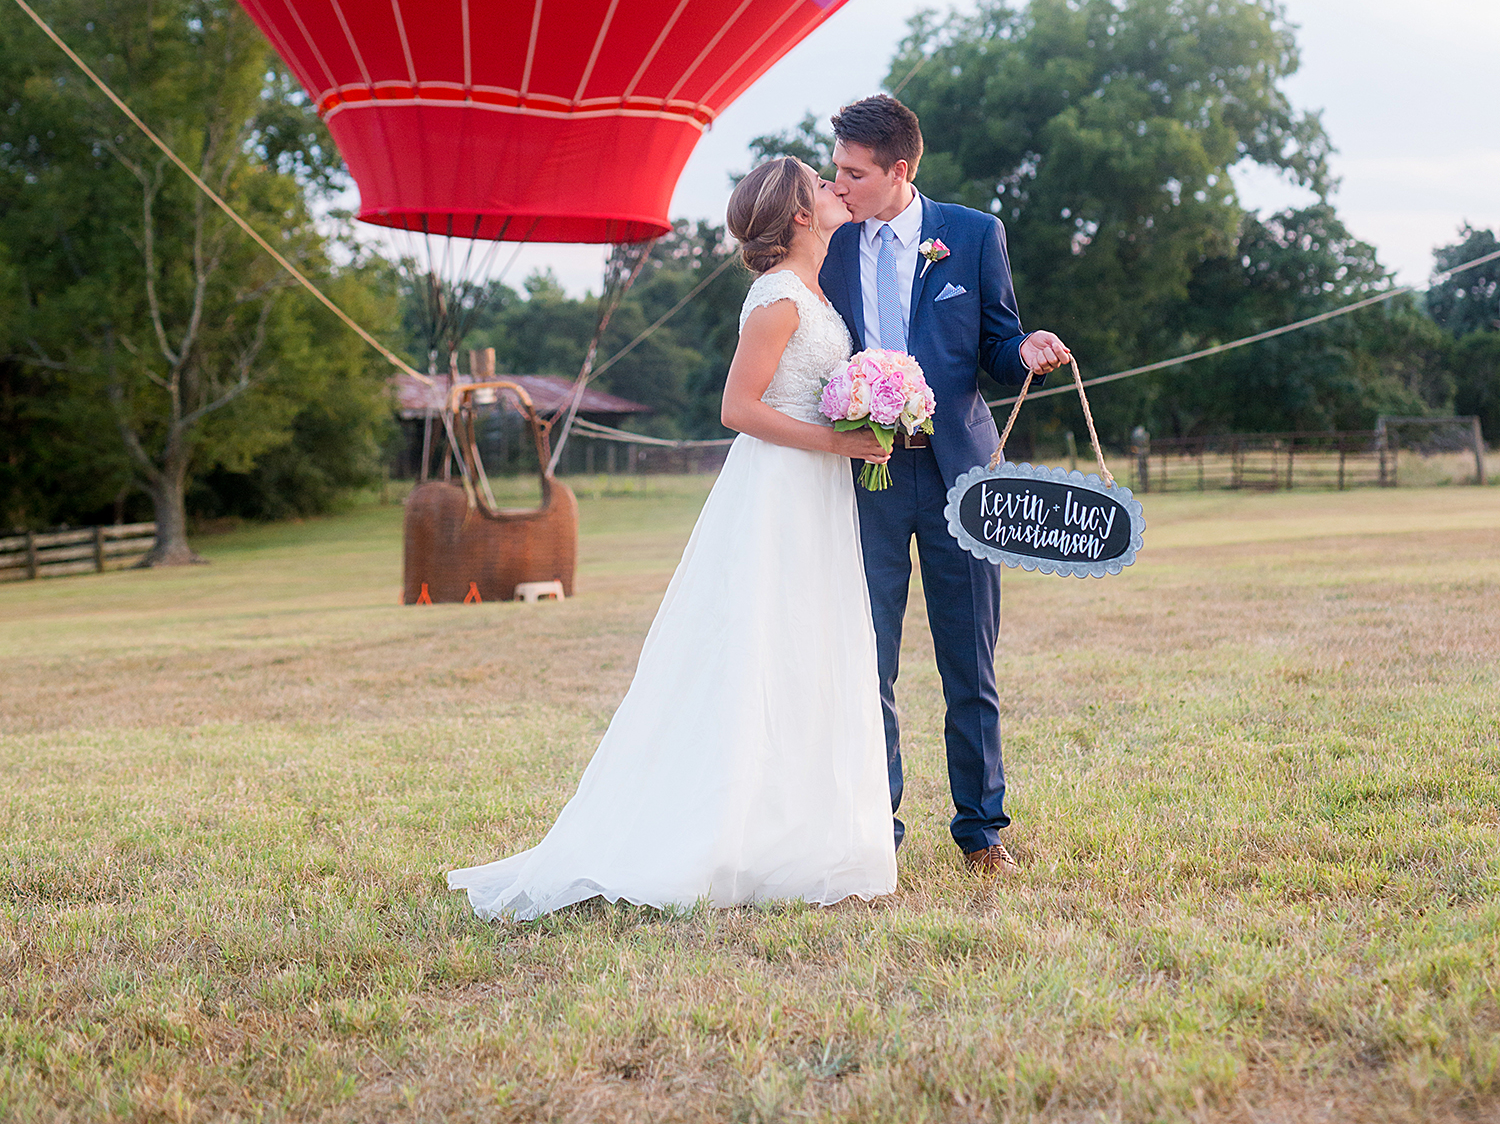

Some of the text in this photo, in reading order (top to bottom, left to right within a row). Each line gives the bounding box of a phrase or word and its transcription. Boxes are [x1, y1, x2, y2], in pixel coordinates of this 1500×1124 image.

[1052, 503, 1060, 512] +
[1064, 490, 1116, 540] lucy
[983, 518, 1105, 560] christiansen
